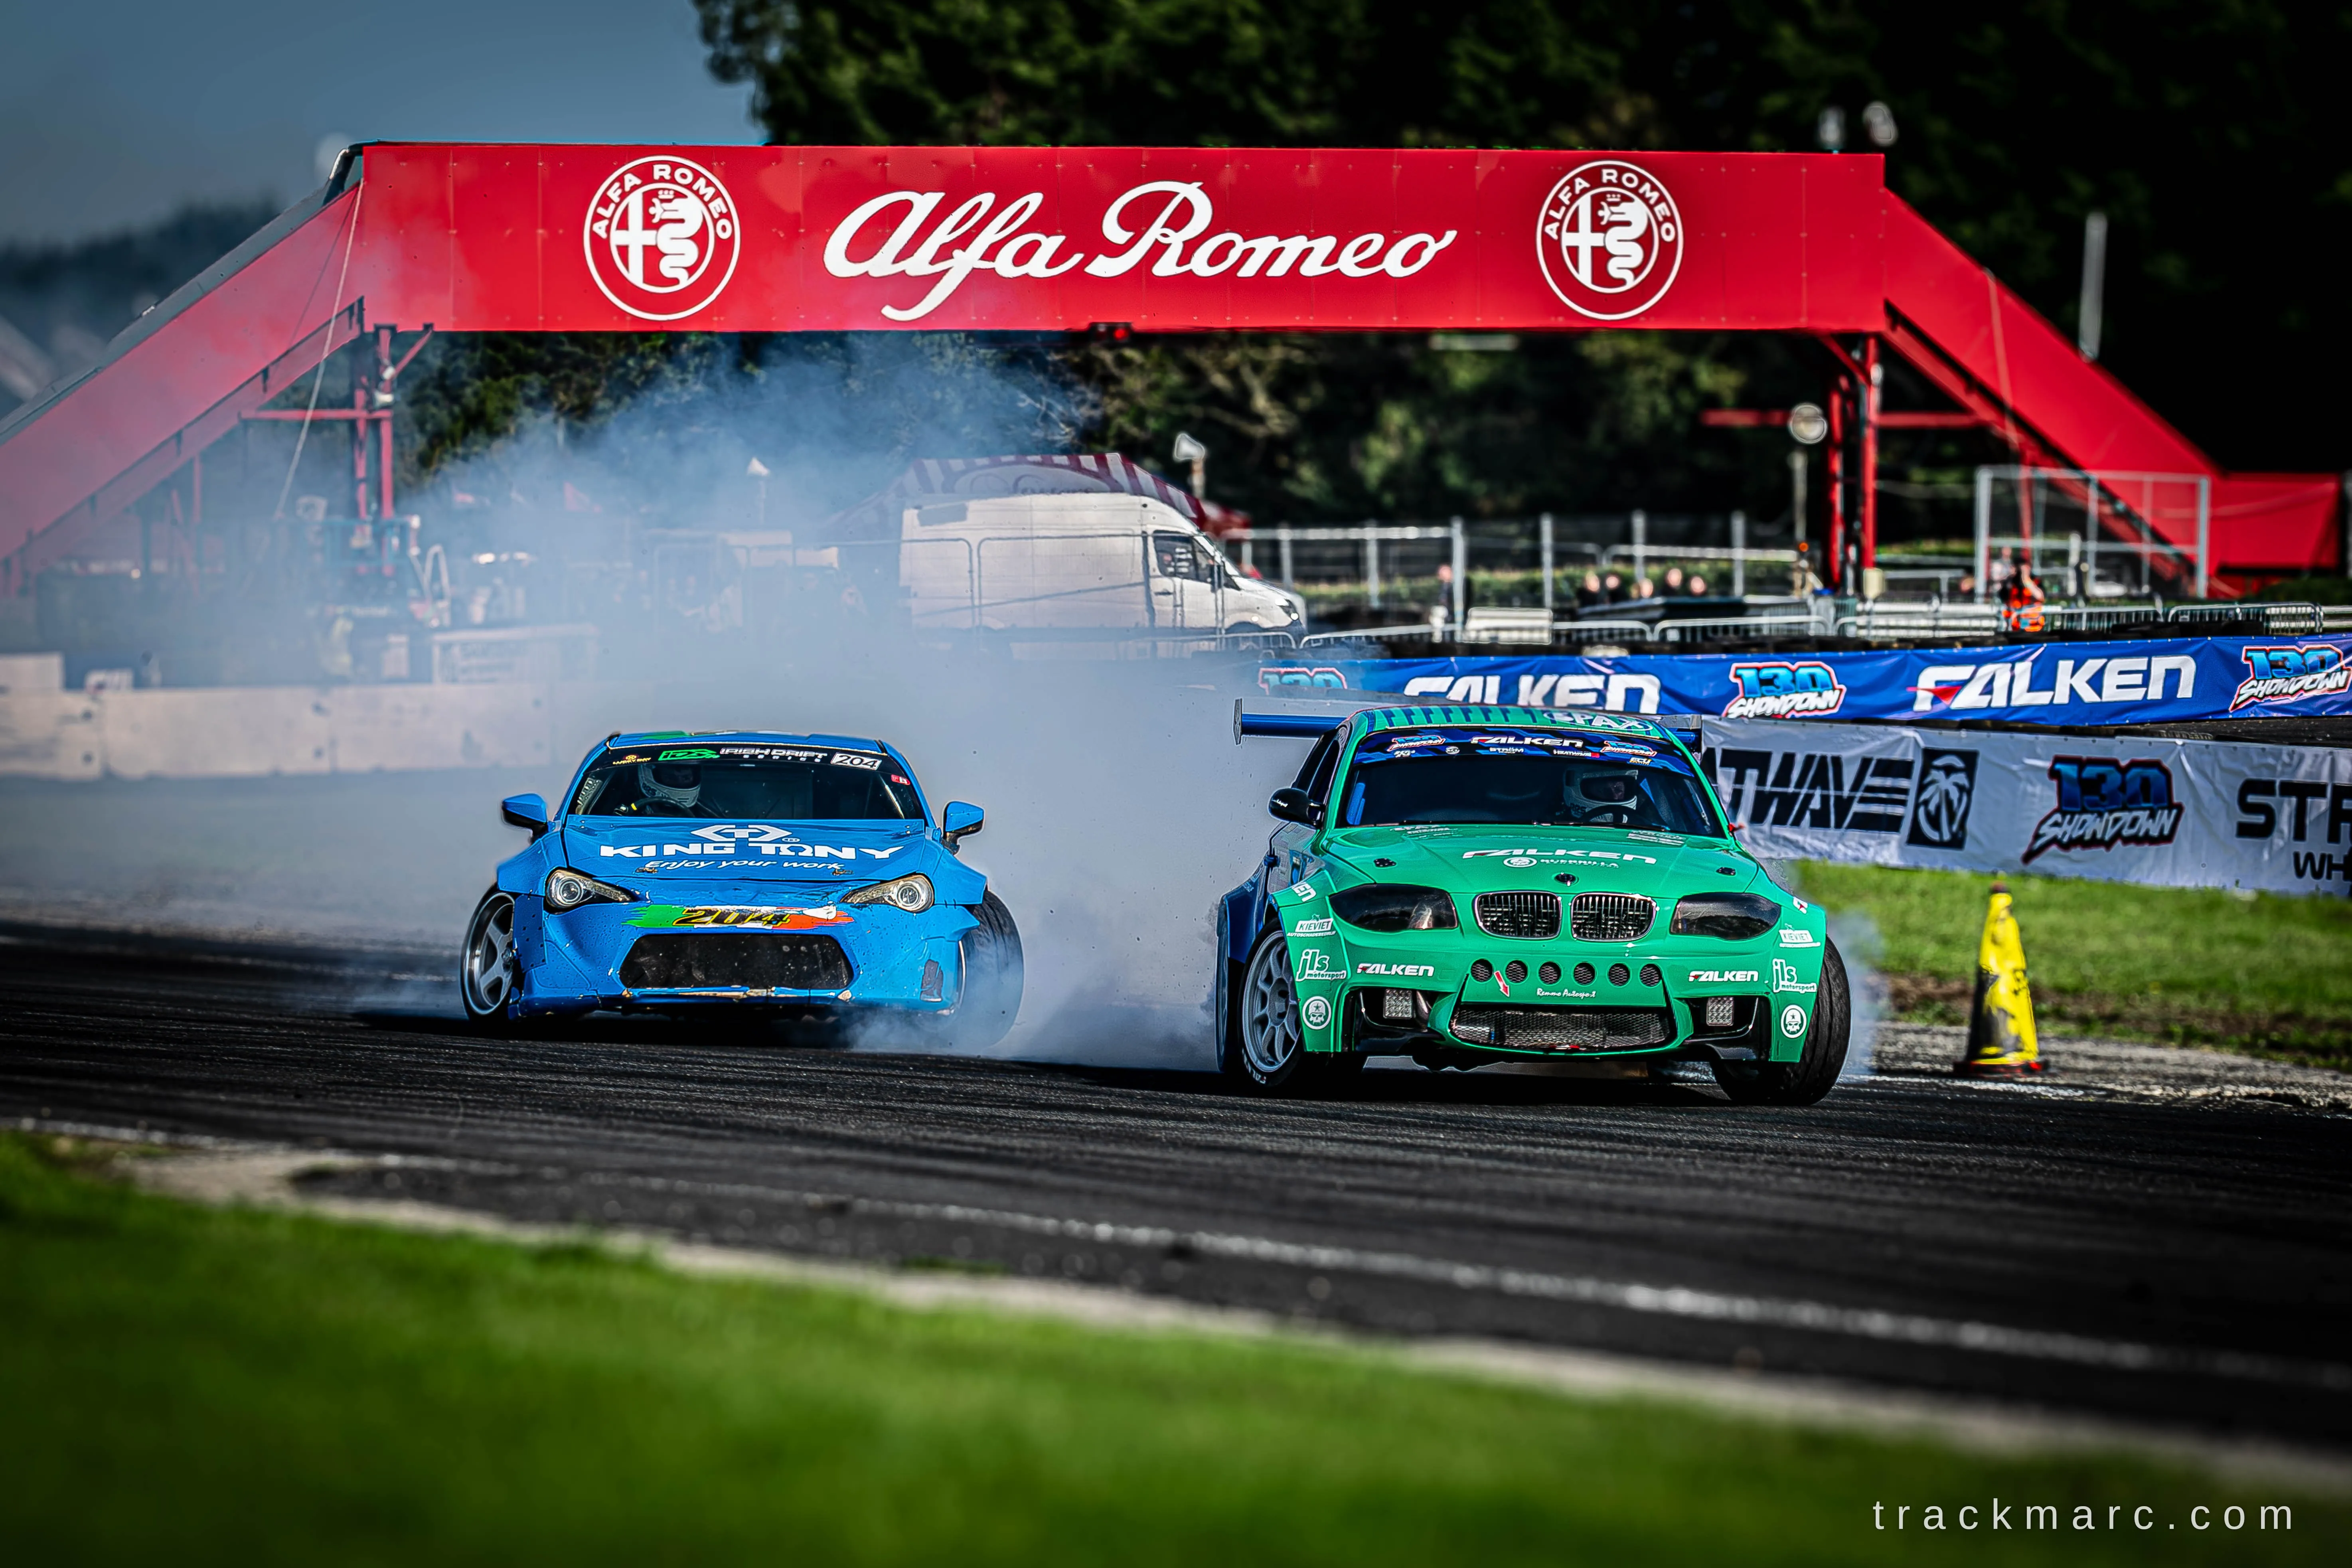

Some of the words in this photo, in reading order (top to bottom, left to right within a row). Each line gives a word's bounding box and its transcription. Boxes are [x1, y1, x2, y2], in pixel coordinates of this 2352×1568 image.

[591, 172, 642, 239] ALFA
[653, 164, 733, 240] ROMEO
[1543, 176, 1590, 240] ALFA
[1600, 168, 1676, 243] ROMEO
[823, 191, 1084, 321] Alfa
[1084, 180, 1458, 277] Romeo
[2247, 649, 2341, 679] 130
[1734, 666, 1835, 697] 130
[1911, 655, 2196, 713] FALKEN
[2237, 669, 2349, 704] SHOWDOWN
[1728, 689, 1840, 718] SHOWDOWN
[770, 749, 827, 758] DRIFT
[1470, 736, 1584, 747] FALKEN
[836, 754, 877, 768] 204
[2053, 763, 2168, 812] 130
[2032, 808, 2177, 851] SHOWDOWN
[600, 843, 736, 857] KING
[748, 843, 906, 860] TONY
[644, 859, 715, 870] Enjoy
[717, 860, 777, 870] your
[782, 861, 847, 870] work
[1462, 849, 1657, 865] FALKEN
[1299, 921, 1331, 931] KIEVIET
[1296, 949, 1329, 981] jls
[1307, 971, 1345, 980] motorsport
[1357, 962, 1434, 977] FALKEN
[1688, 970, 1759, 982] FALKEN
[1773, 958, 1797, 993] jls
[1781, 983, 1815, 991] motorsport
